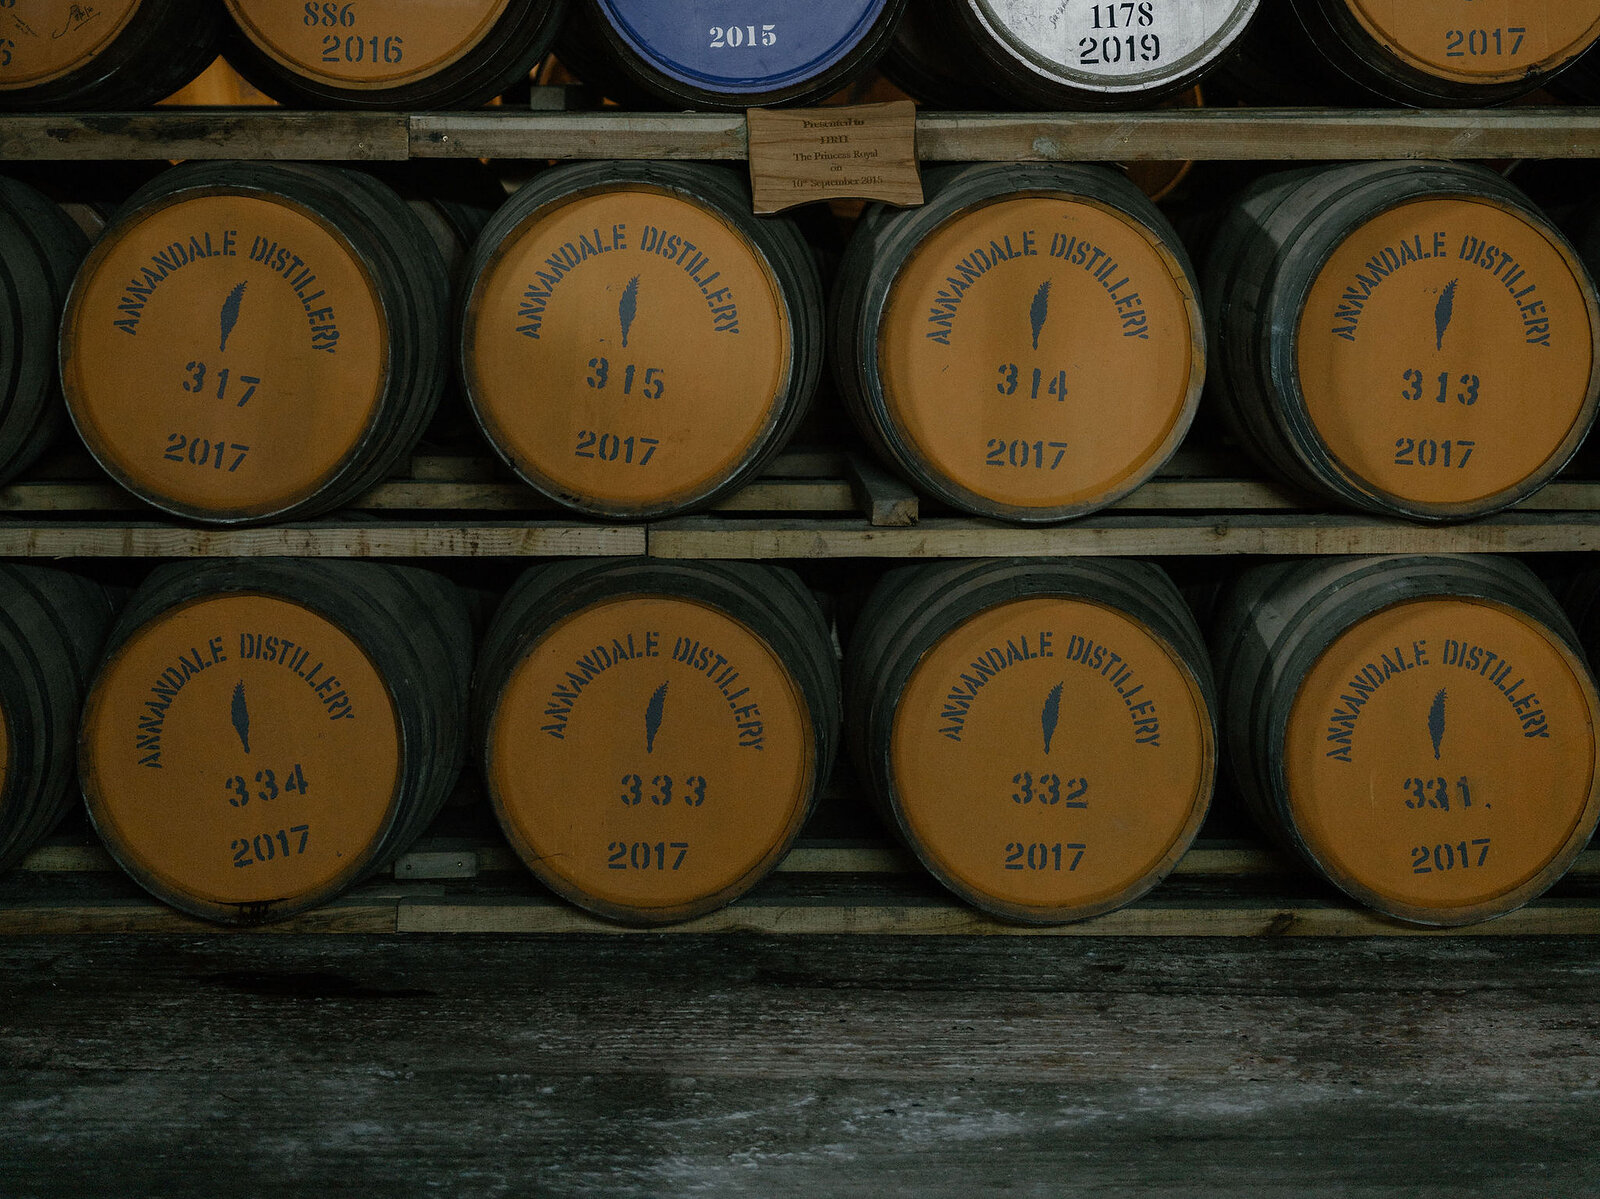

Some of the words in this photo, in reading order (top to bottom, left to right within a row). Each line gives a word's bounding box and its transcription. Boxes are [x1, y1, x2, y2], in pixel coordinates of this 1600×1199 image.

[303, 2, 356, 28] 886
[1090, 2, 1154, 30] 1178
[321, 35, 404, 64] 2016
[709, 24, 778, 49] 2015
[1078, 33, 1161, 65] 2019
[1445, 28, 1526, 57] 2017
[803, 118, 852, 129] Presented
[793, 152, 812, 161] The
[813, 152, 852, 161] Princess
[853, 150, 878, 160] Royal
[830, 164, 842, 172] on
[810, 177, 860, 189] September
[112, 230, 237, 336] ANNANDALE
[249, 235, 340, 354] DISTILLERY
[515, 224, 628, 340] ANNANDALE
[640, 225, 739, 334] DISTILLERY
[926, 230, 1038, 345] ANNANDALE
[1049, 232, 1149, 340] DISTILLERY
[1331, 231, 1447, 342] ANNANDALE
[1458, 234, 1551, 347] DISTILLERY
[182, 361, 261, 408] 317
[586, 357, 665, 400] 315
[1401, 368, 1480, 406] 313
[163, 432, 250, 472] 2017
[575, 430, 660, 466] 2017
[986, 438, 1068, 470] 2017
[1394, 437, 1476, 469] 2017
[136, 636, 227, 769] ANNANDALE
[239, 633, 355, 721] DISTILLERY
[540, 631, 660, 740] ANNANDALE
[672, 636, 764, 751] DISTILLERY
[938, 631, 1054, 742] ANNANDALE
[1066, 634, 1160, 747] DISTILLERY
[1326, 639, 1430, 763] ANNANDALE
[1442, 638, 1550, 740] DISTILLERY
[225, 764, 309, 808] 334
[620, 774, 707, 807] 333
[1011, 772, 1088, 809] 332
[230, 824, 310, 868] 2017
[607, 841, 689, 870] 2017
[1004, 842, 1087, 872] 2017
[1411, 838, 1491, 874] 2017
